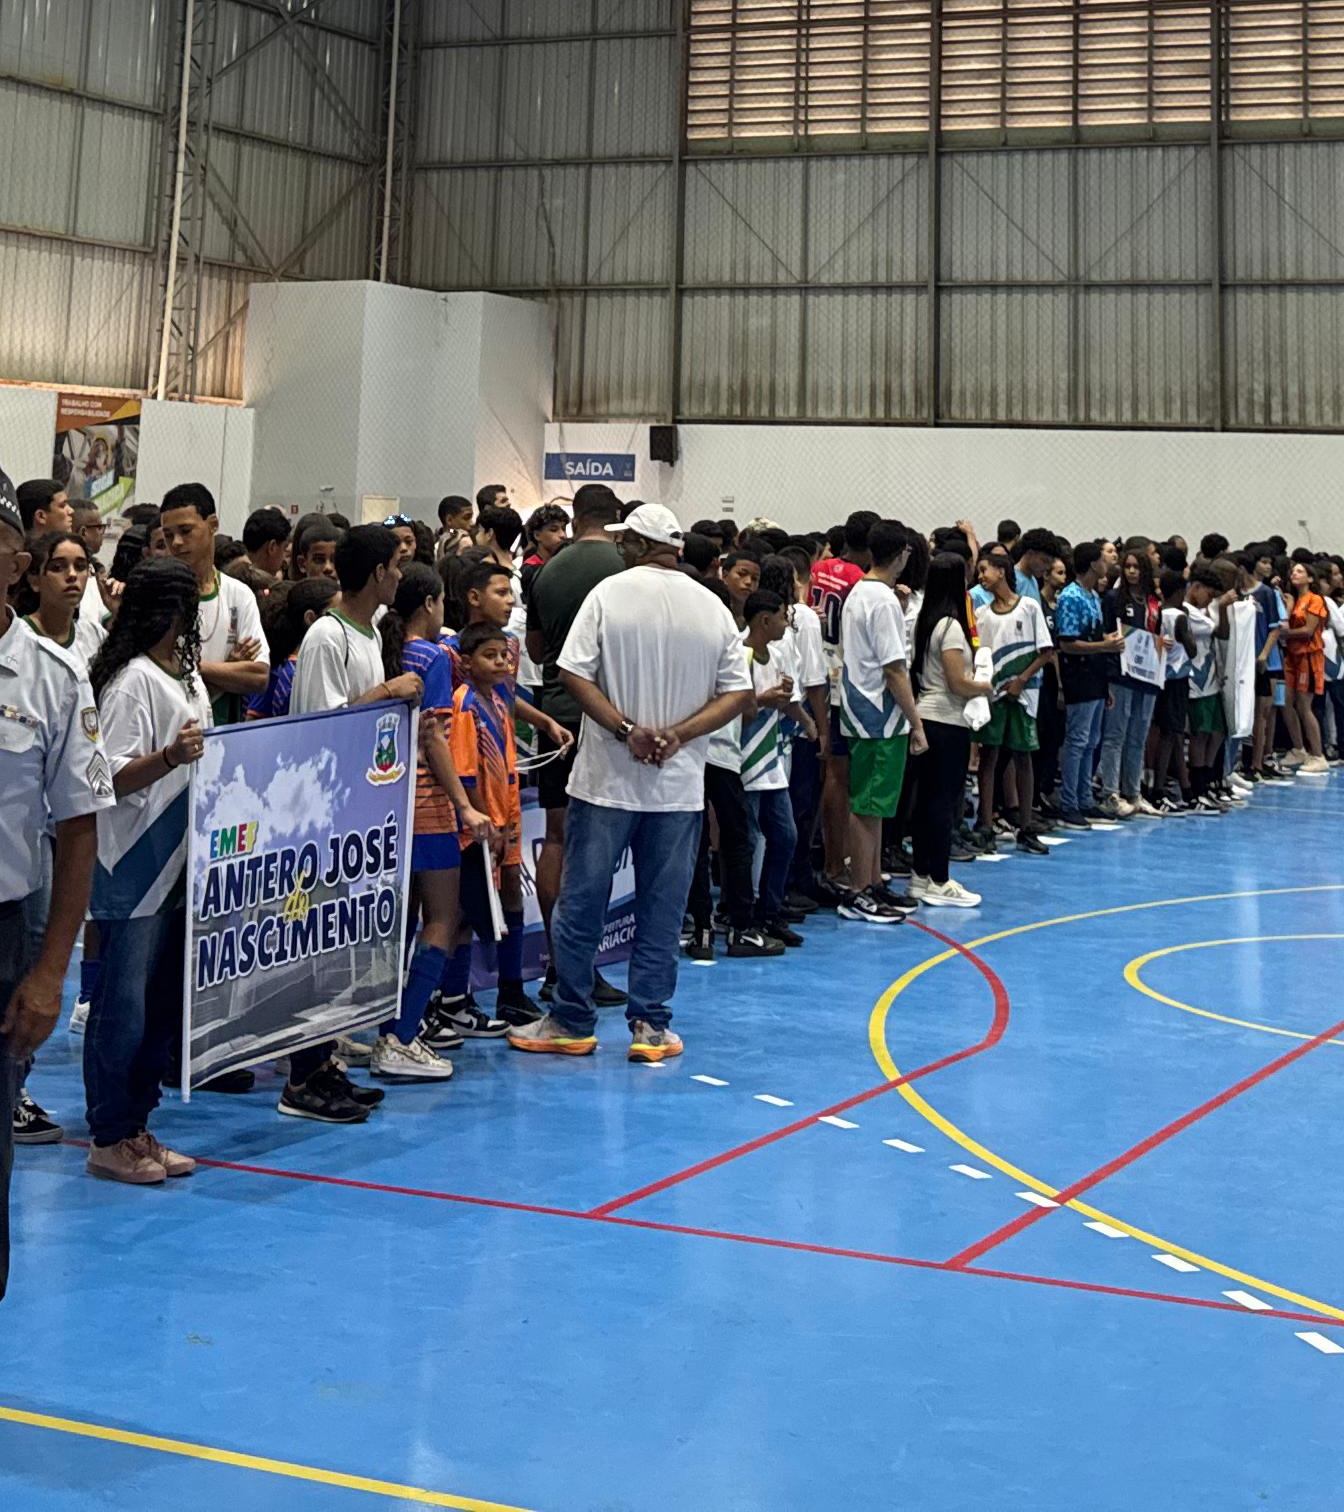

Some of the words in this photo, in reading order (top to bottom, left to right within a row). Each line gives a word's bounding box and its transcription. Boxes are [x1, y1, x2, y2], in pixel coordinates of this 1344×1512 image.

[564, 458, 614, 476] SAÍDA
[200, 842, 319, 920] ANTERO
[324, 811, 398, 887] JOSÉ
[209, 820, 257, 860] EMEF
[197, 888, 396, 991] NASCIMENTO
